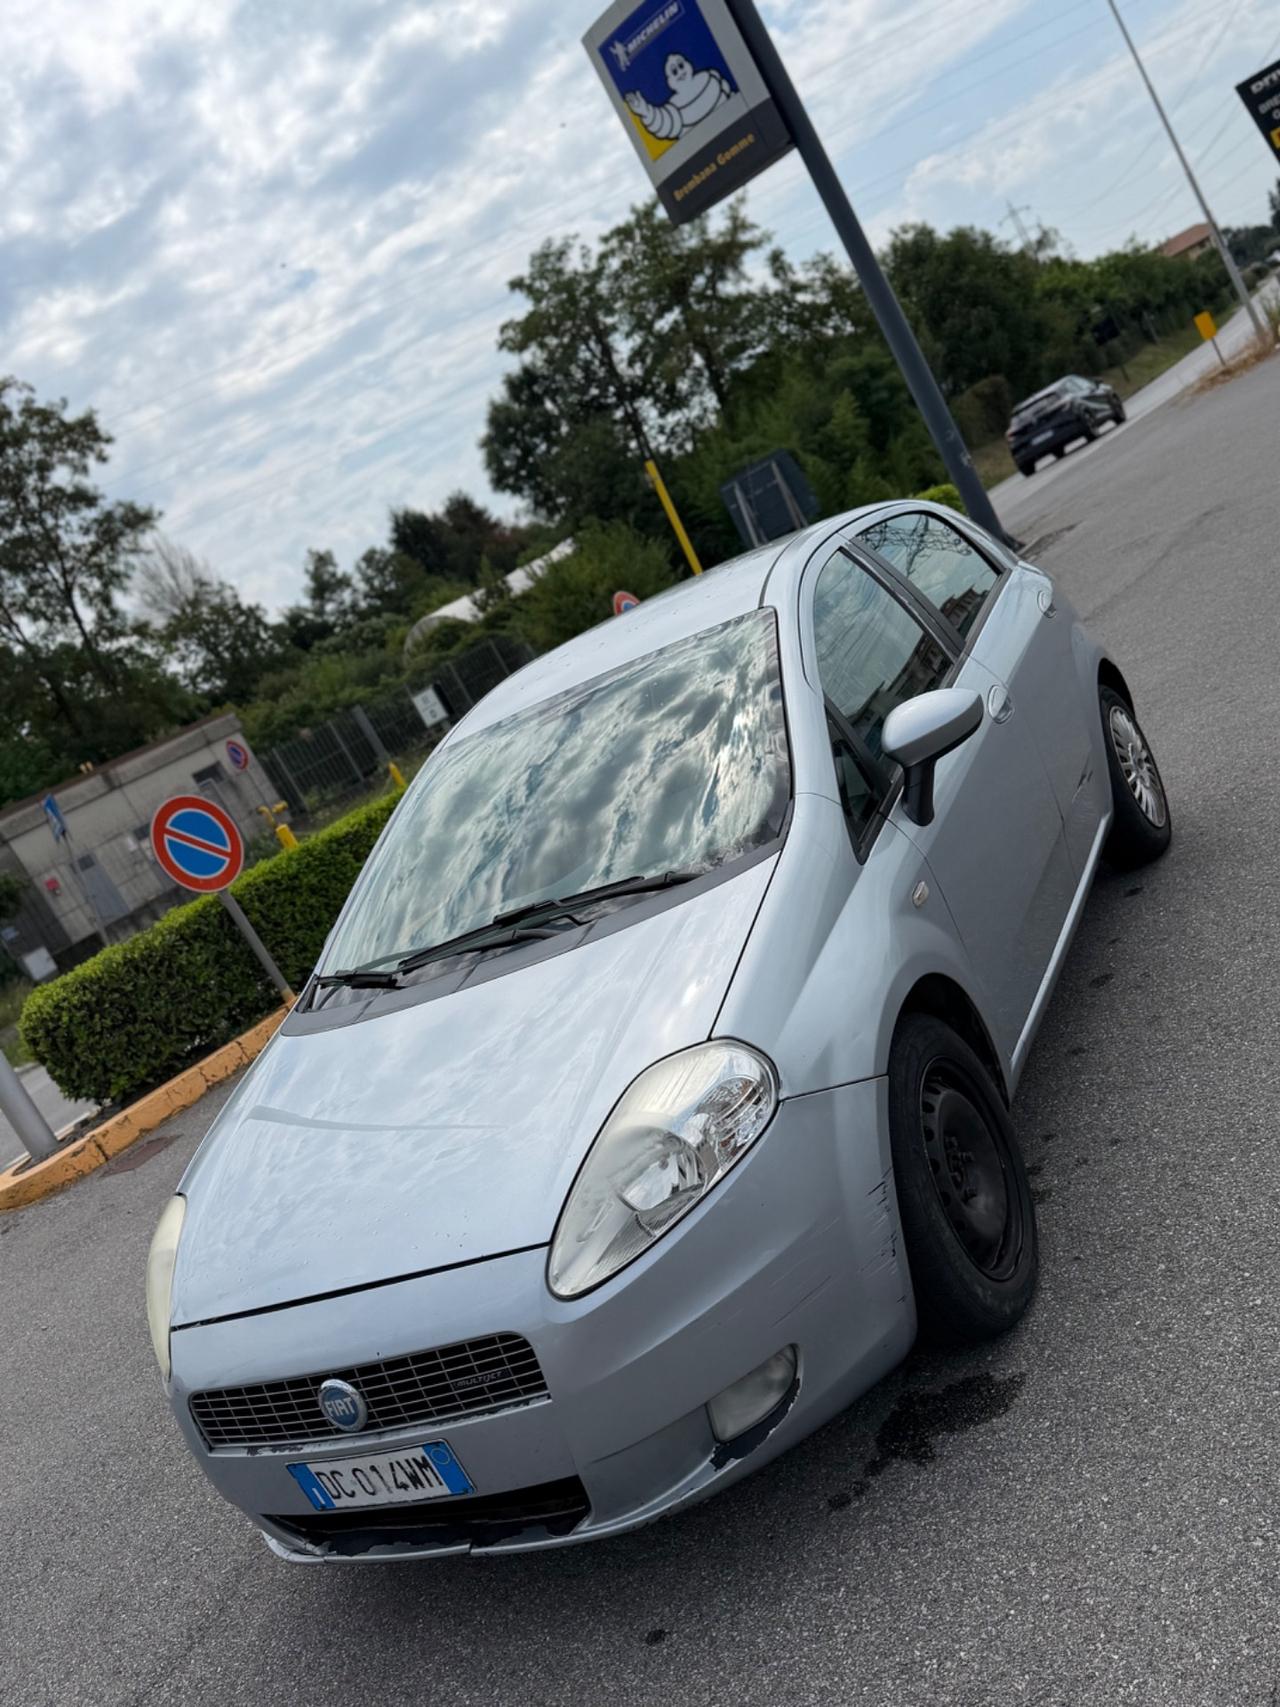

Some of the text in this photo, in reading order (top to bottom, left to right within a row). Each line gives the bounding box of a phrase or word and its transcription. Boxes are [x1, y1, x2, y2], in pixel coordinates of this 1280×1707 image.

[626, 1, 680, 53] MICHELIN
[717, 133, 755, 166] Gomme
[324, 1396, 355, 1417] FIAT
